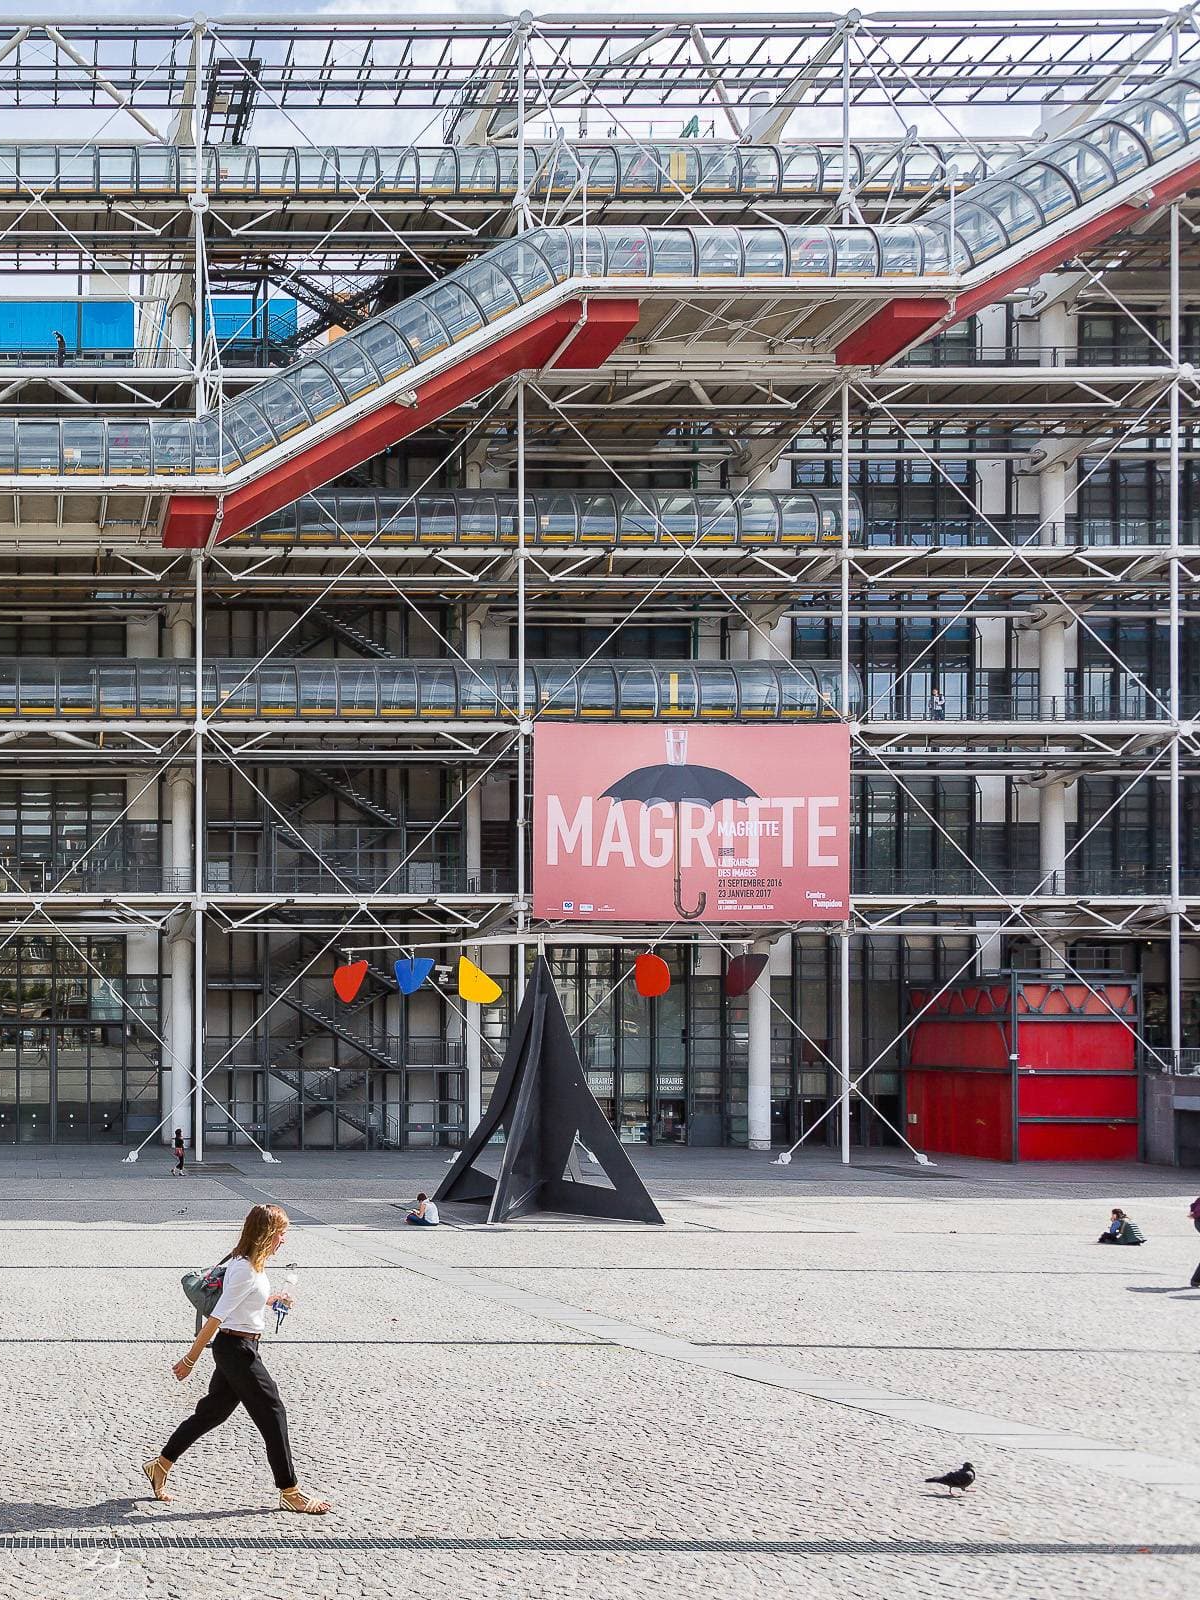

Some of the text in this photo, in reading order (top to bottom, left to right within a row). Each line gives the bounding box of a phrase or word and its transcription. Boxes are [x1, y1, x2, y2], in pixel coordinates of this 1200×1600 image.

[546, 794, 840, 868] MAGRITTE
[717, 820, 780, 837] MAGRITTE
[718, 878, 783, 888] 21 SEPTEMBRE 2016
[718, 889, 772, 898] 23 JANVIER 2017
